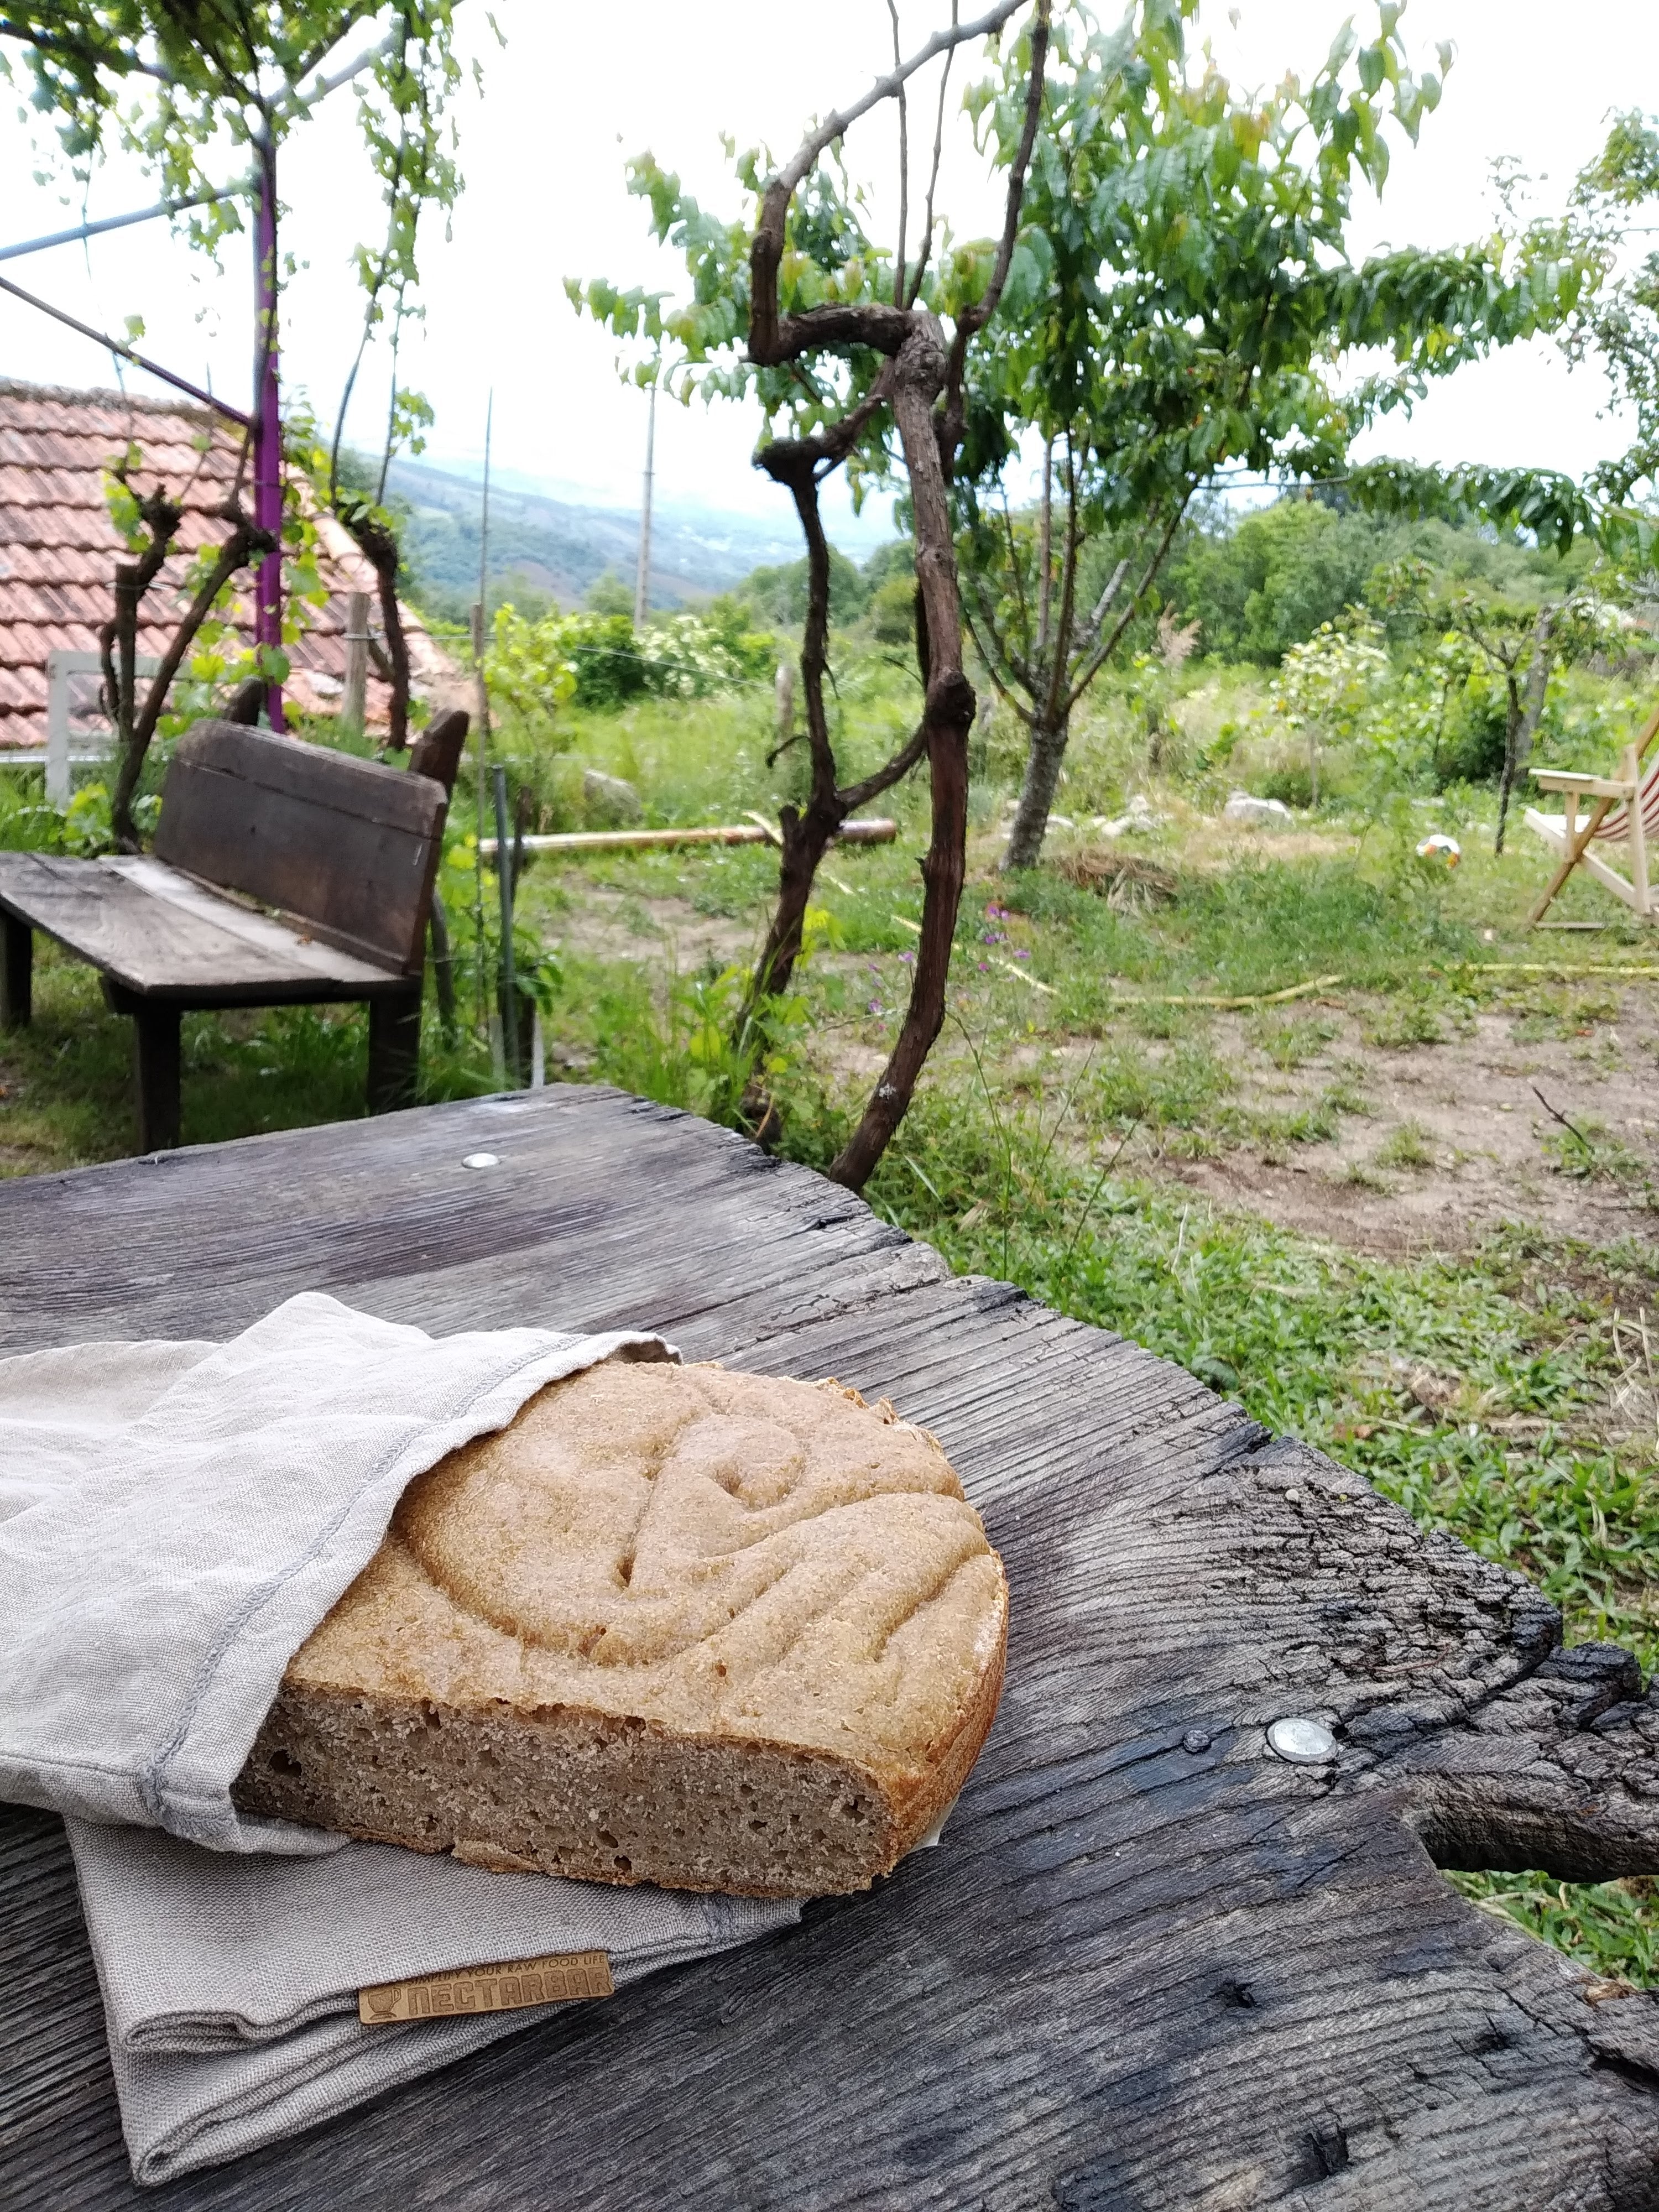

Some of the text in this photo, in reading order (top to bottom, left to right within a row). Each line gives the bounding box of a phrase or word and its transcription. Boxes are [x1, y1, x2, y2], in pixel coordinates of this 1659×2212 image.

[467, 1965, 502, 1978] YOUR
[507, 1961, 536, 1973] RAW
[542, 1957, 578, 1969] FOOD
[583, 1954, 605, 1965] LIFE
[407, 1966, 612, 2016] NECTARBAR
